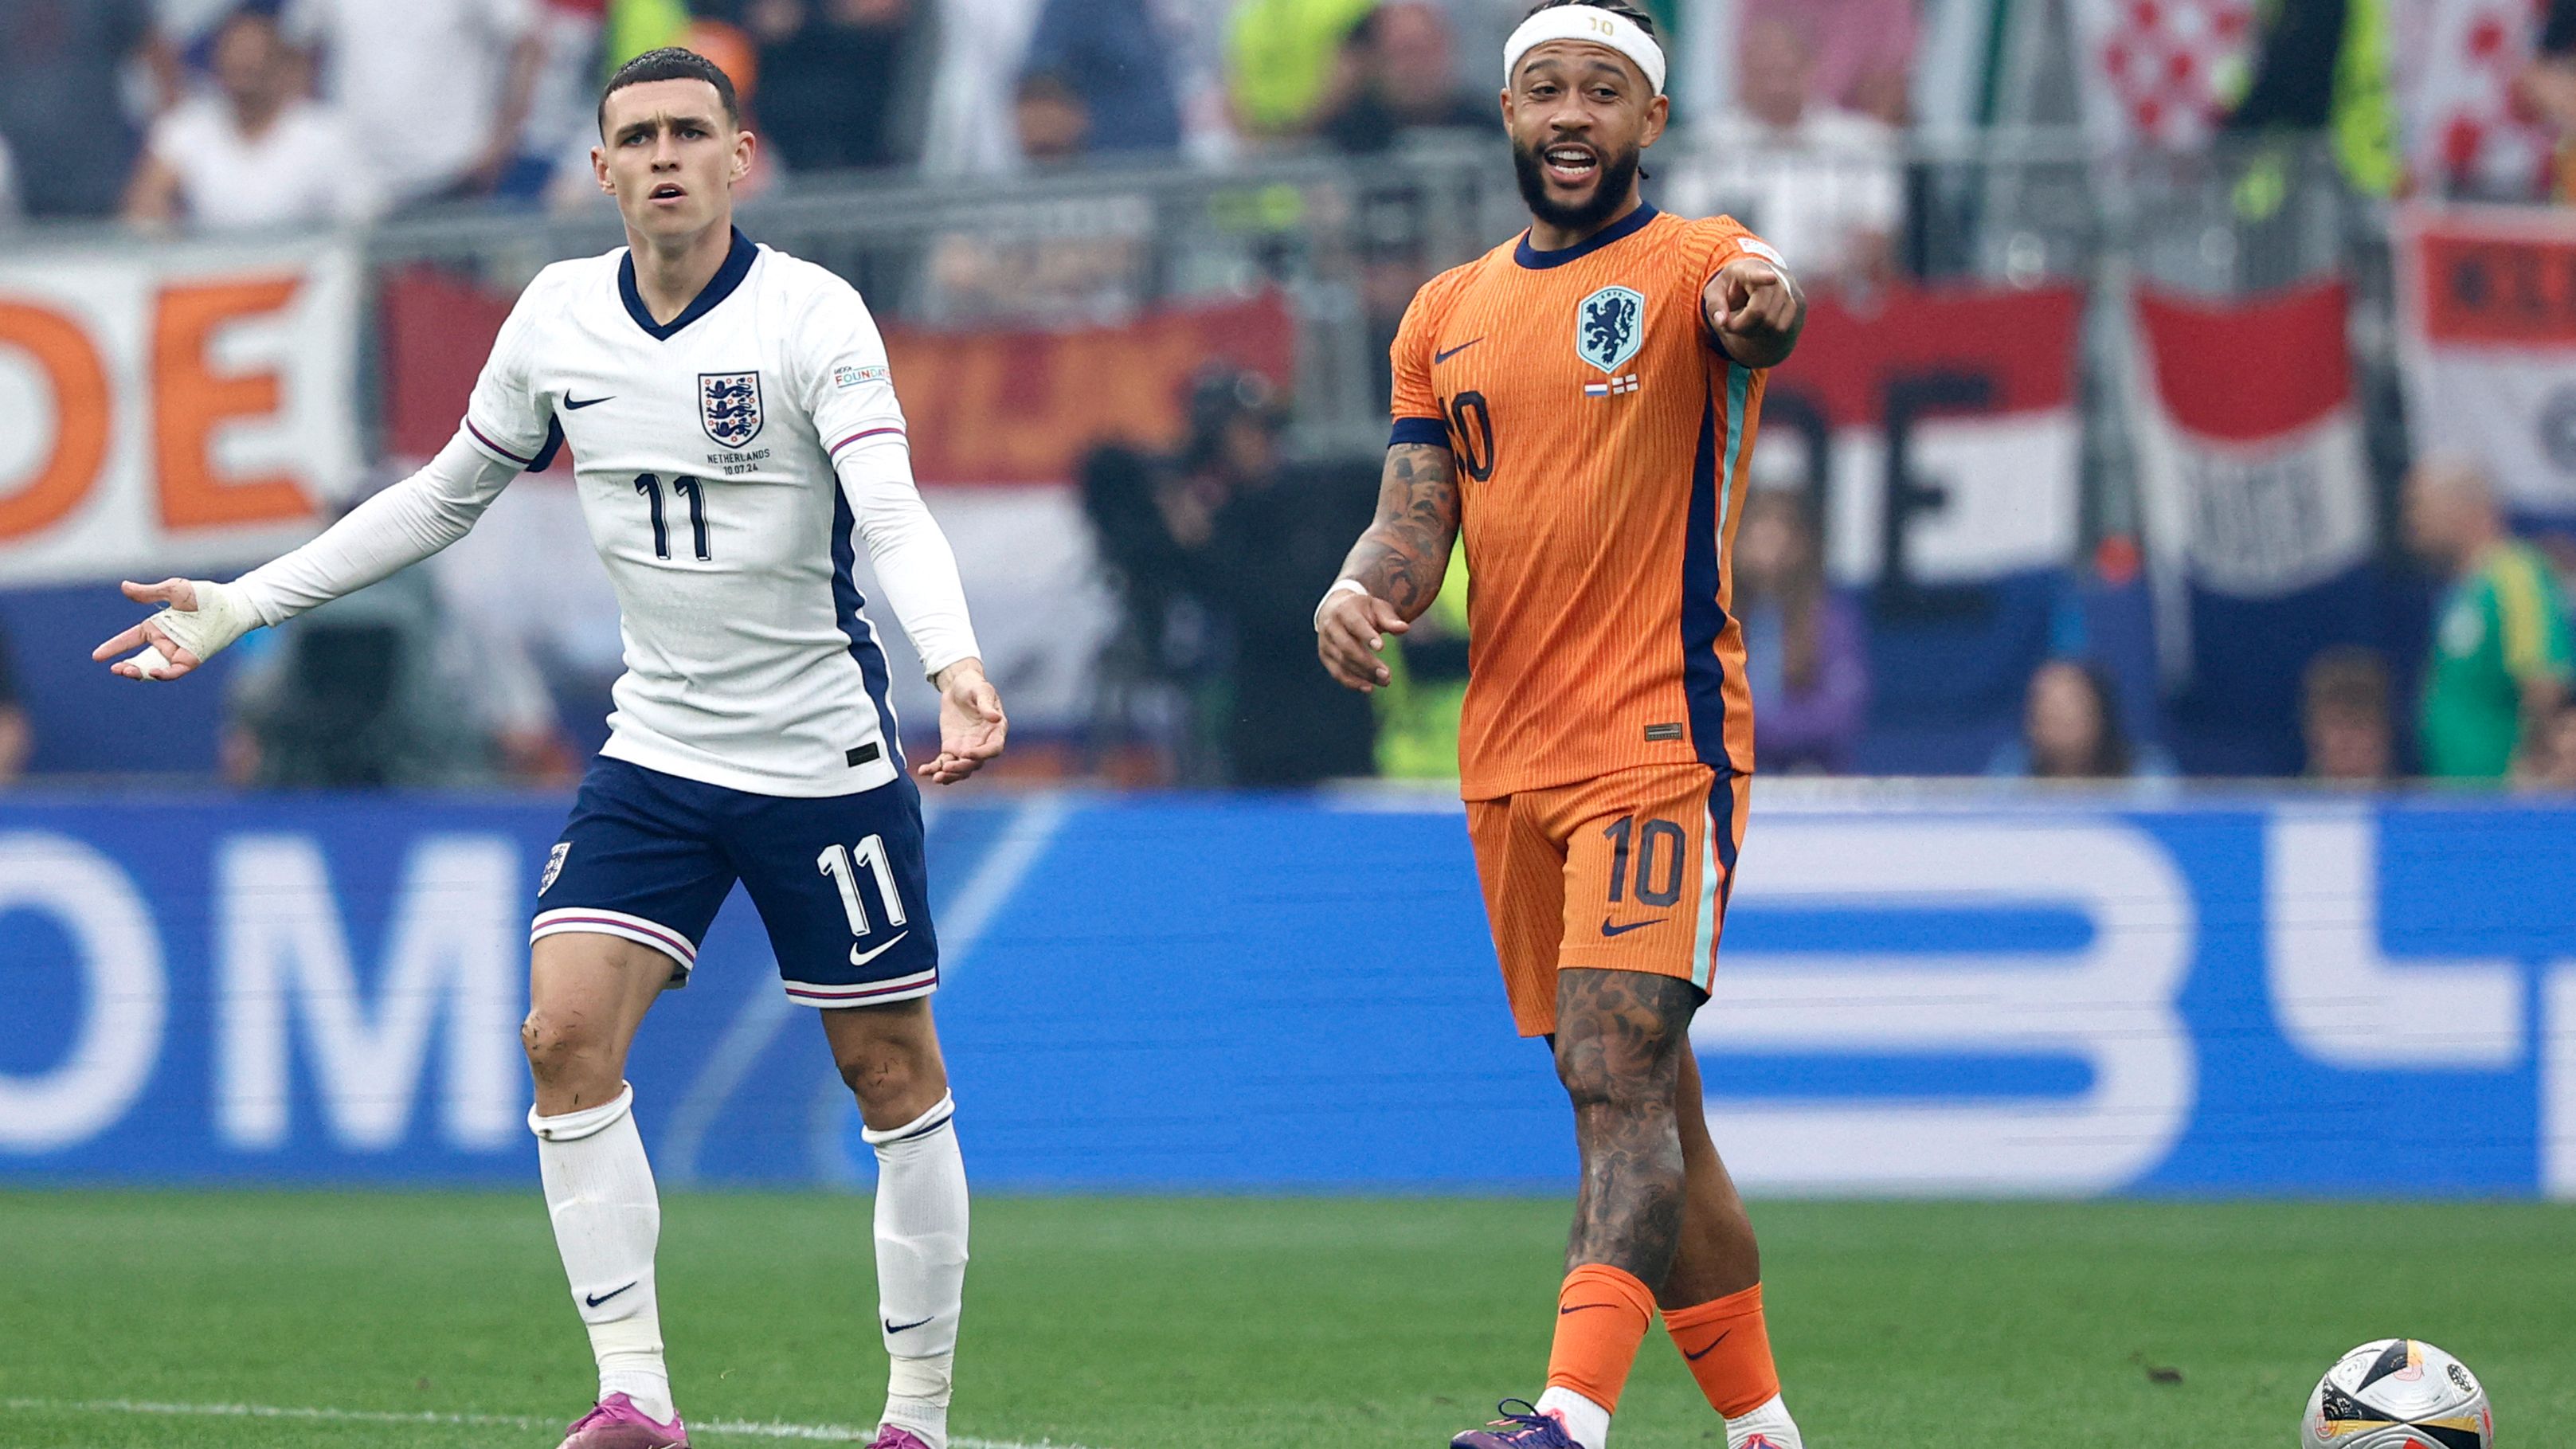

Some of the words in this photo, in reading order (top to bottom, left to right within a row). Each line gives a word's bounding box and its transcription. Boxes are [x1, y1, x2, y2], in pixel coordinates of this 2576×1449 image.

[1588, 17, 1614, 37] 10
[836, 368, 891, 385] FOUNDAT
[707, 448, 770, 464] NETHERLANDS
[1438, 390, 1494, 484] 10
[723, 463, 758, 476] 10.07.24
[634, 473, 711, 561] 11
[816, 832, 908, 938] 11
[1603, 814, 1686, 907] 10
